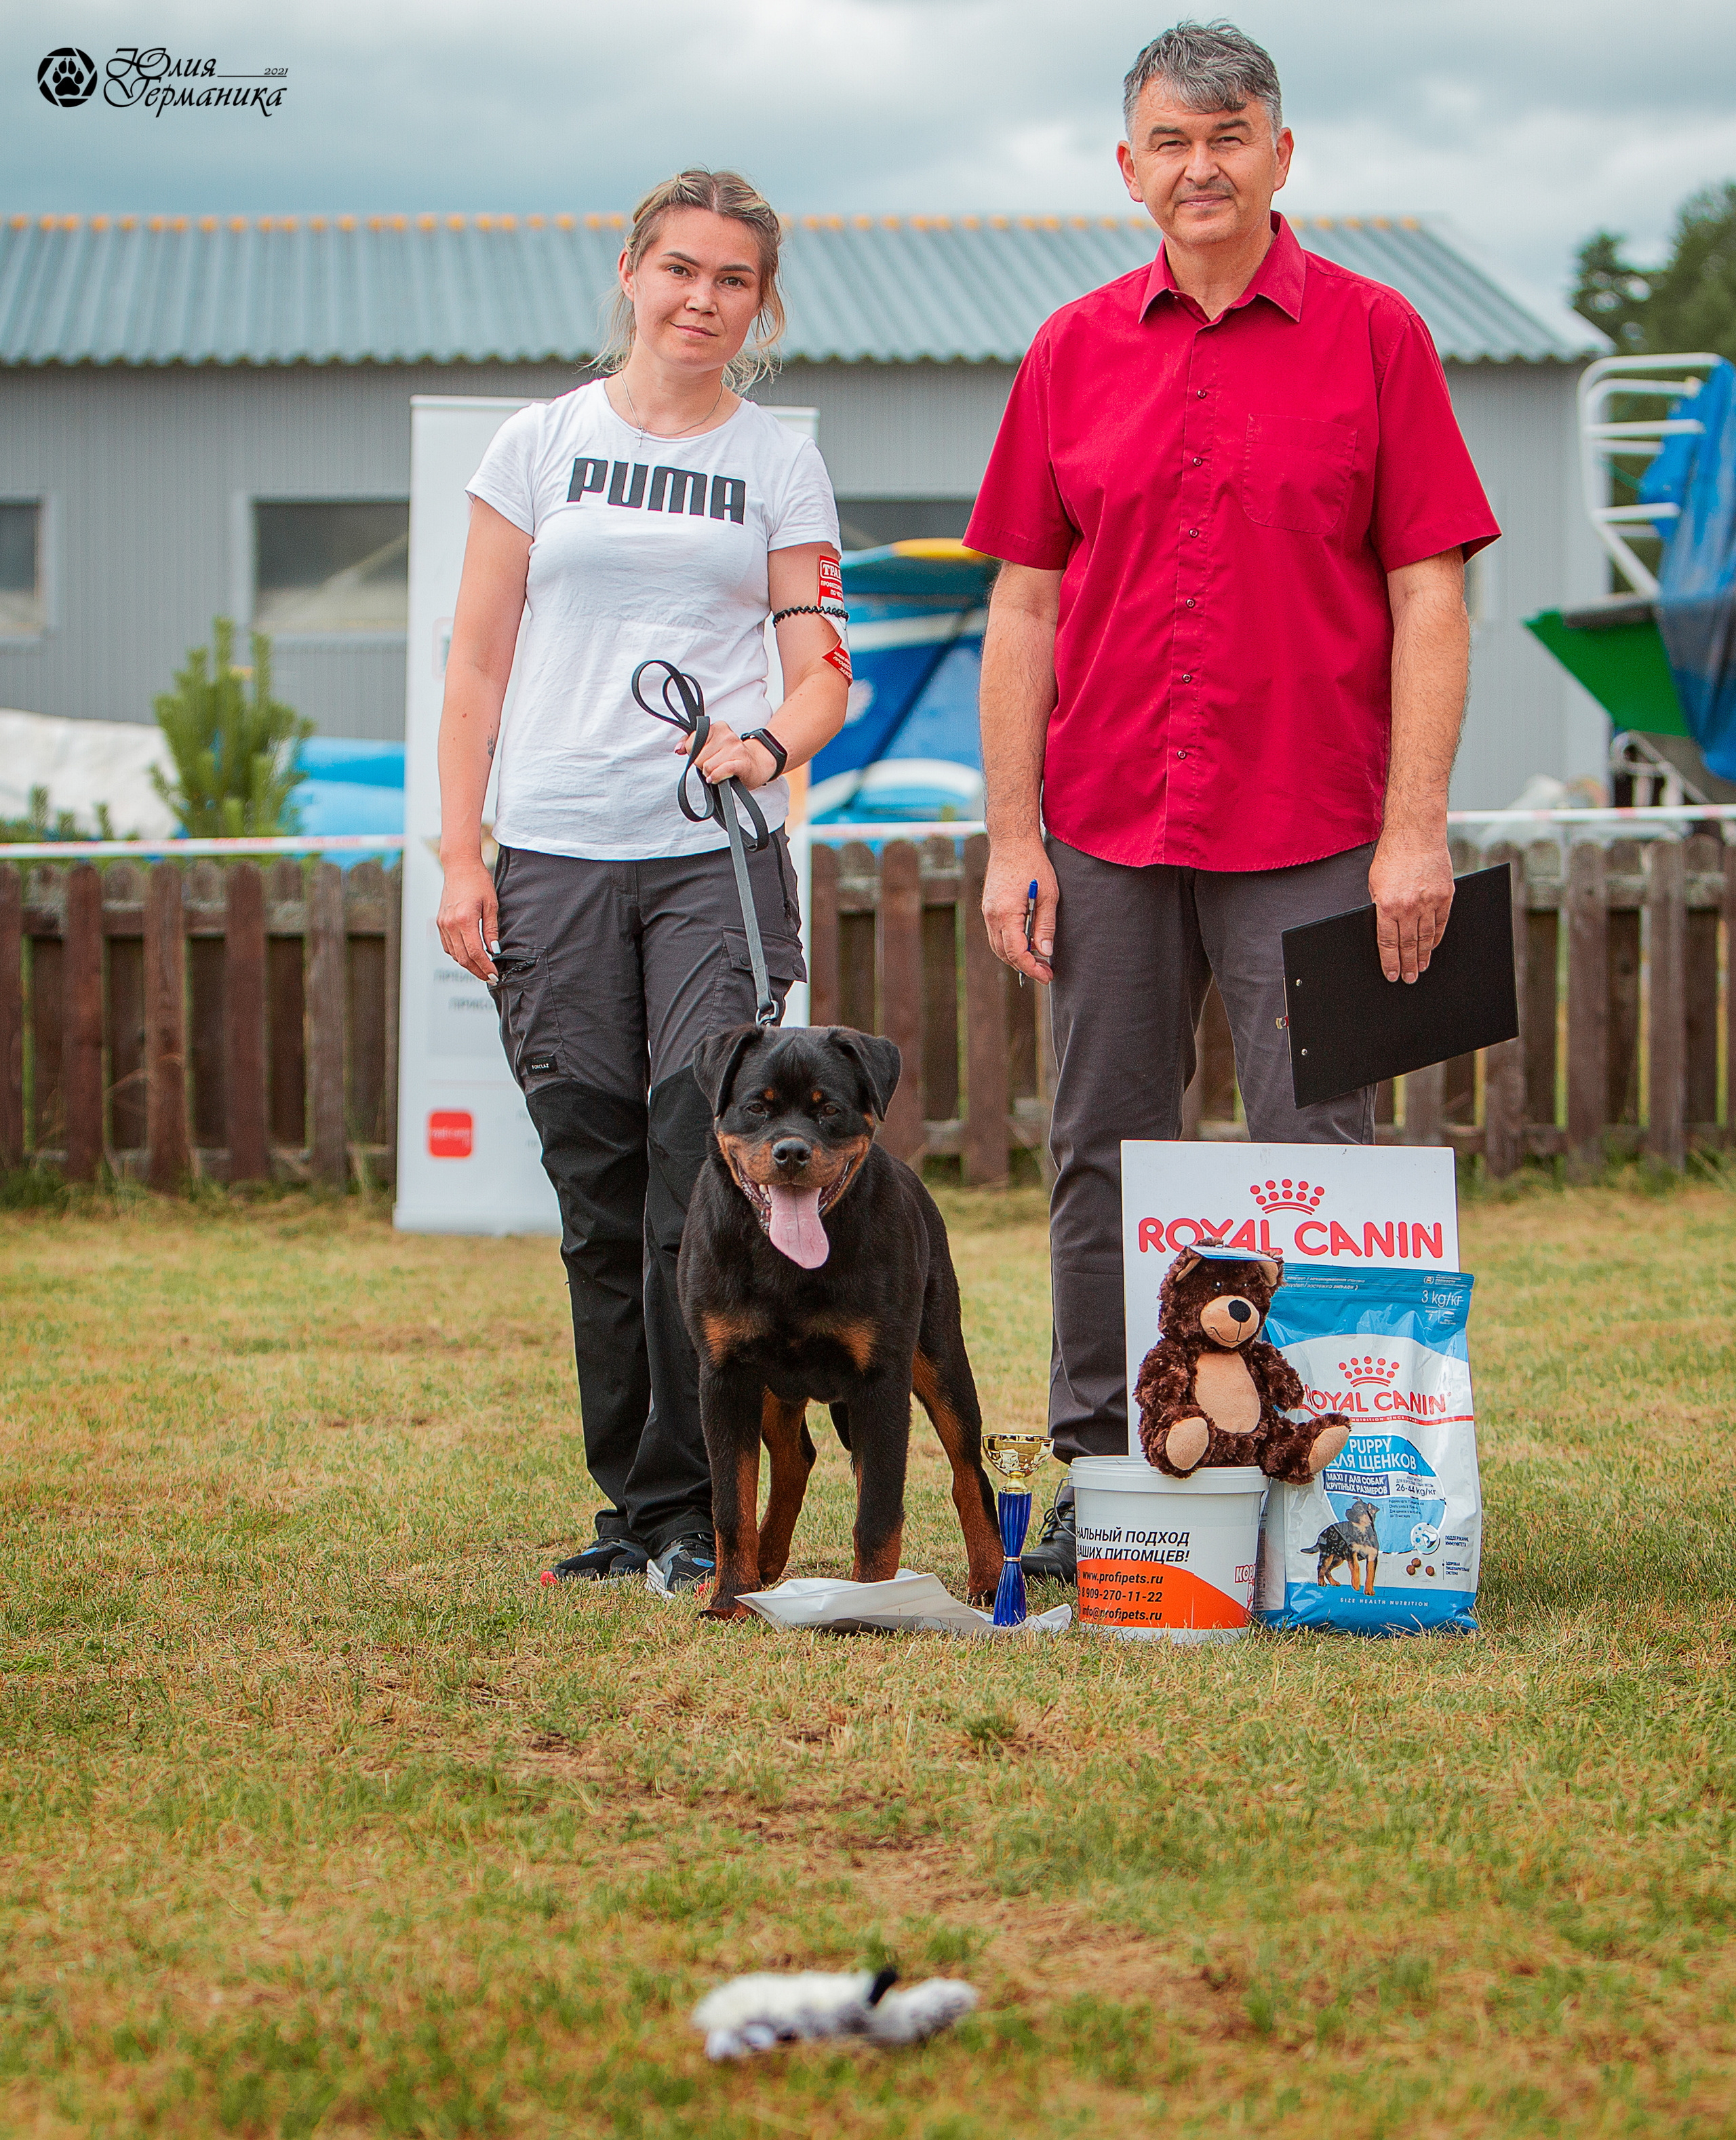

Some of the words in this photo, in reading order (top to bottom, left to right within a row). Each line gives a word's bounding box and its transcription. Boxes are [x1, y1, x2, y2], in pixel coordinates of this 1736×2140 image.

[567, 458, 746, 525] PUMA
[1138, 1218, 1283, 1255] ROYAL
[1294, 1220, 1443, 1258] CANIN
[1421, 1289, 1428, 1303] 3
[1304, 1384, 1368, 1412] ROYAL
[1374, 1390, 1446, 1415] CANIN
[1349, 1437, 1392, 1454] PUPPY
[1358, 1453, 1417, 1472] ЩЕНКОВ
[1326, 1473, 1343, 1481] MAXI
[1362, 1477, 1384, 1485] СОБАК
[1326, 1482, 1356, 1492] КРУПНЫХ
[1357, 1486, 1387, 1495] РАЗМЕРОВ
[1396, 1484, 1415, 1493] 26-44
[1125, 1531, 1190, 1547] ПОДХОД
[1105, 1548, 1190, 1565] ПИТОМЦЕВ!
[1082, 1571, 1164, 1586] www.profipets.ru
[1235, 1564, 1256, 1583] КОР
[1086, 1587, 1163, 1603] 909-270-11-22
[1082, 1604, 1162, 1621] info@profipets.ru
